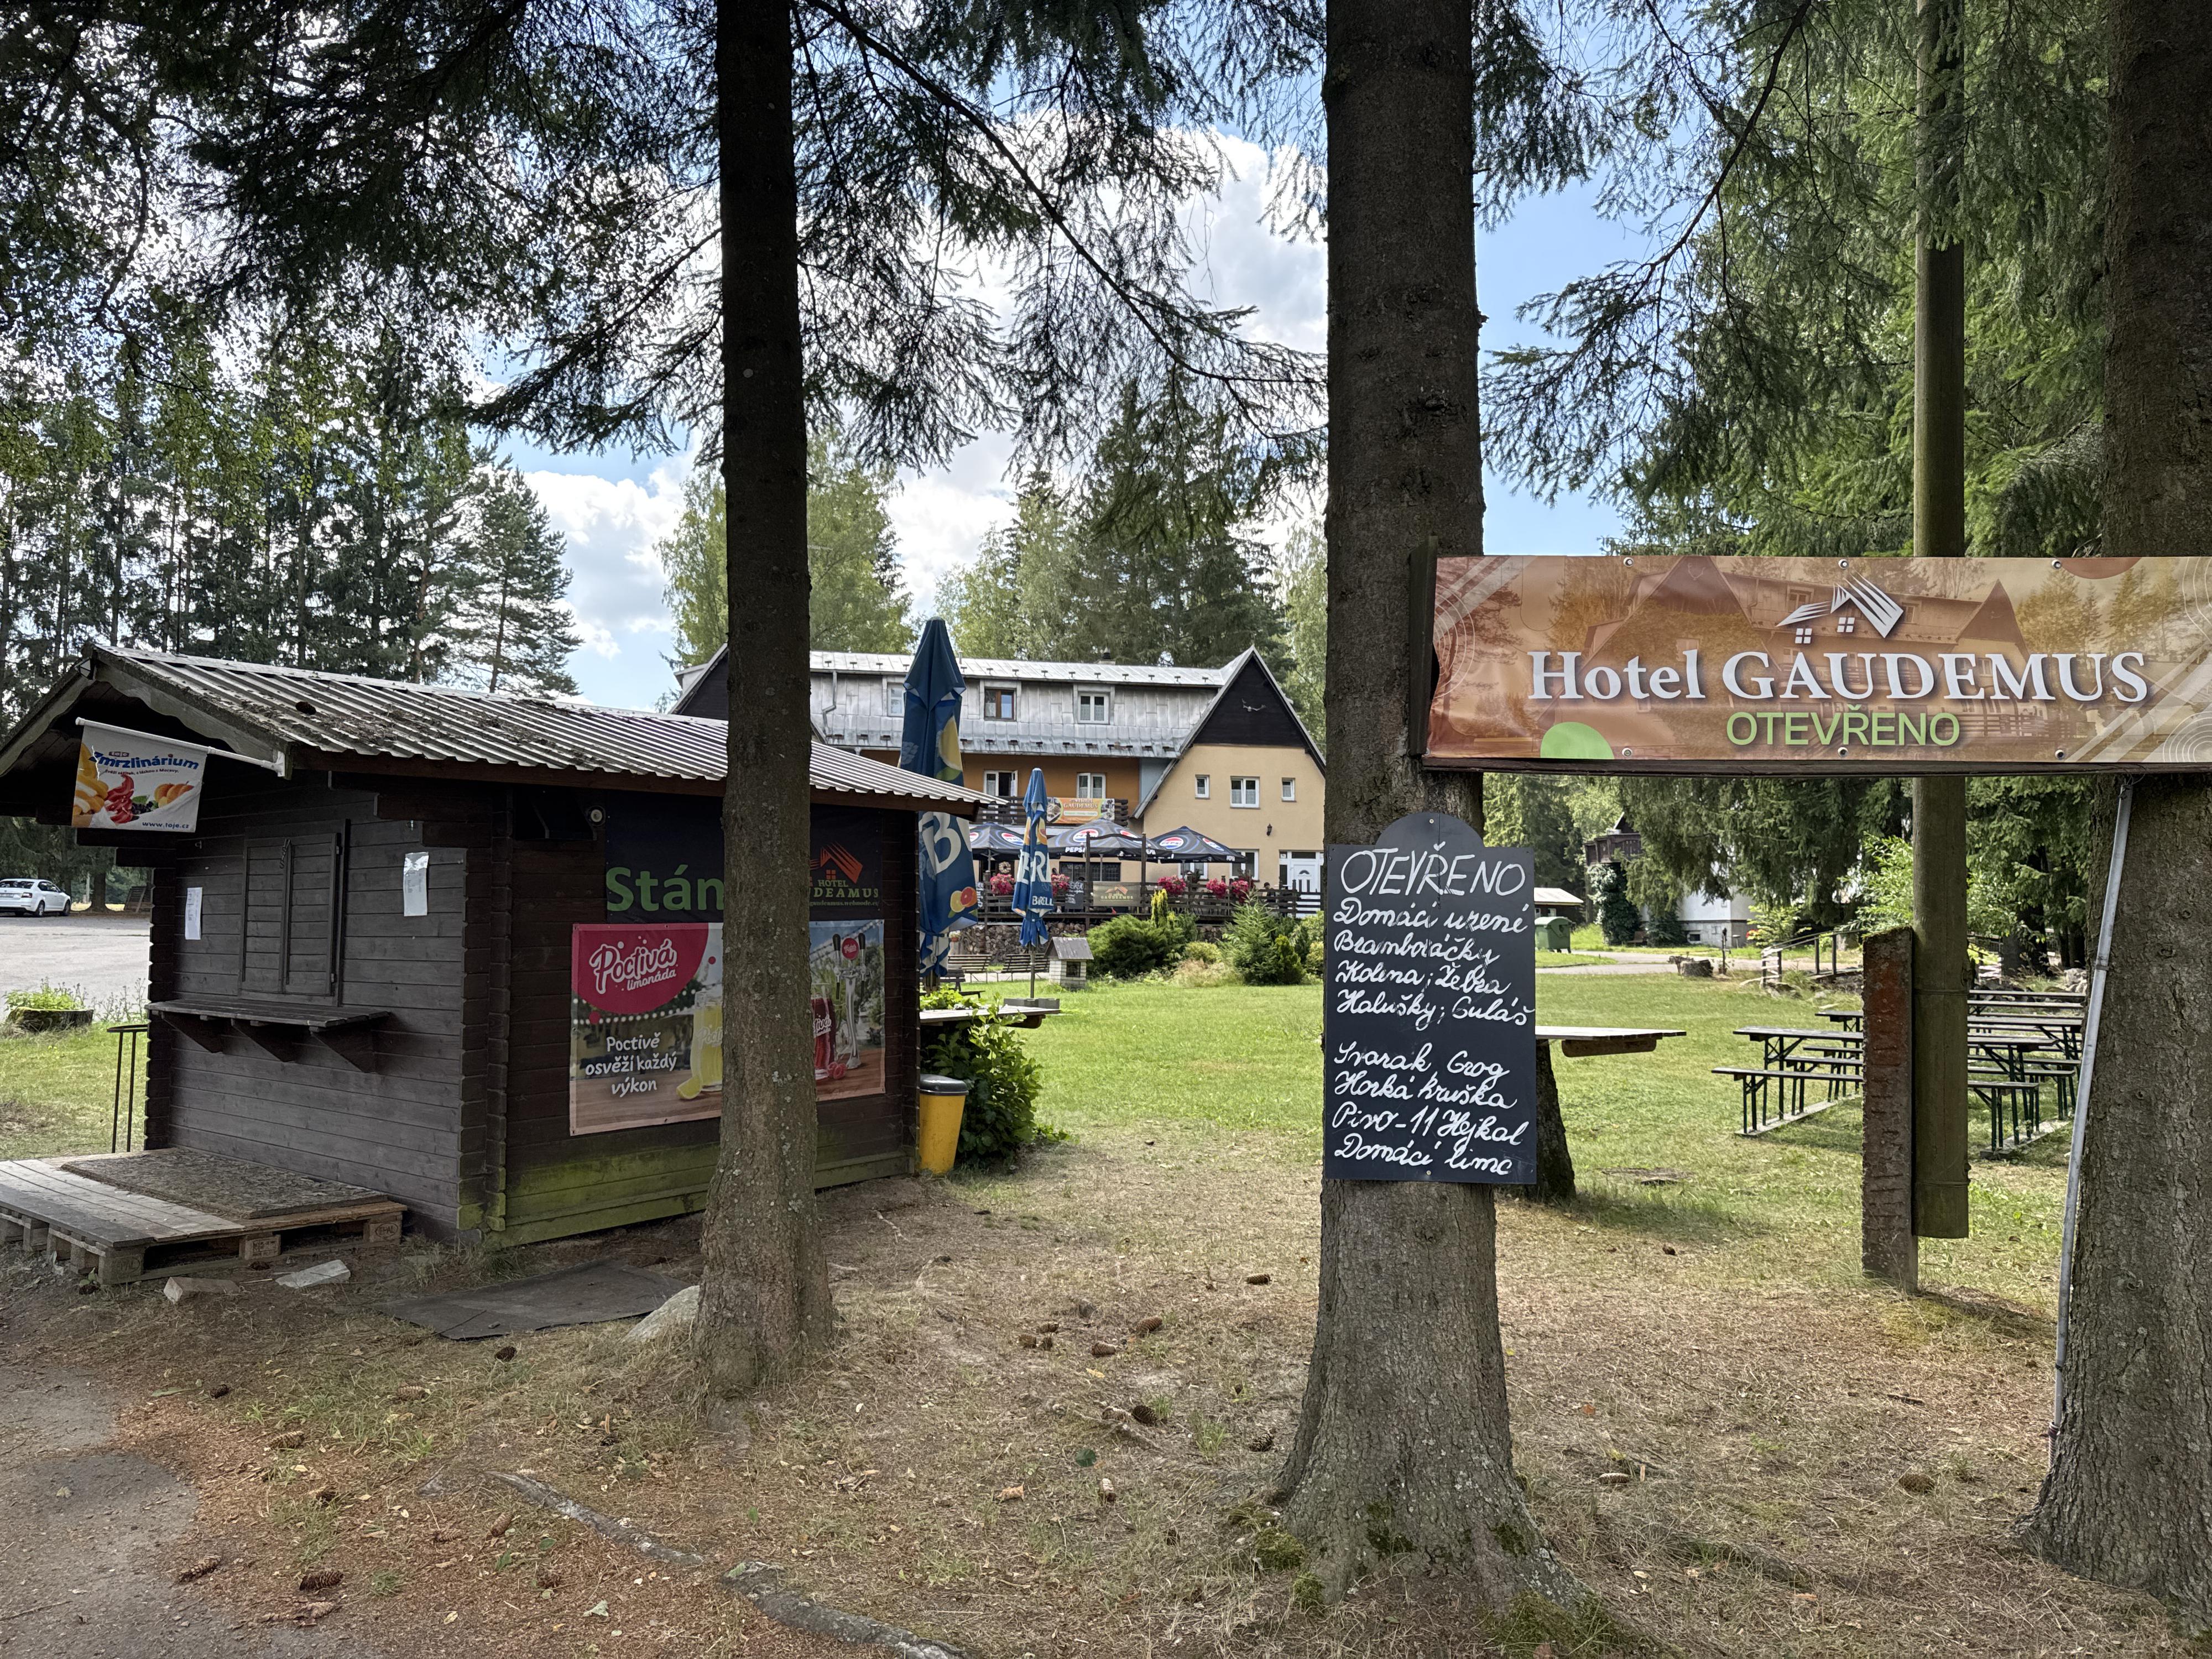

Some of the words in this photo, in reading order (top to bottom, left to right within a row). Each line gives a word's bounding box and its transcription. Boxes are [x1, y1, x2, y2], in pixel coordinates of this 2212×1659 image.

[1527, 649, 1706, 700] Hotel
[1722, 651, 2148, 703] GAUDEMUS
[1726, 704, 1960, 747] OTEVŘENO
[88, 751, 200, 770] Zmrzlinárium
[1341, 841, 1525, 896] OTEVŘENO
[606, 864, 725, 911] Stán
[809, 887, 879, 898] DEAMUS
[1333, 897, 1438, 929] Domácí
[1444, 904, 1529, 933] uzené
[589, 938, 677, 994] Poctivá
[627, 969, 677, 991] limonáda
[1452, 996, 1536, 1025] Guláš
[606, 1032, 661, 1052] Poctivě
[585, 1055, 634, 1076] osvěží
[637, 1051, 677, 1072] každý
[1447, 1050, 1510, 1091] Grog
[612, 1076, 657, 1098] výkon
[1334, 1070, 1415, 1100] Horká
[1417, 1071, 1517, 1109] hruška
[1437, 1109, 1529, 1151] Hejkal
[1334, 1133, 1441, 1166] Domácí
